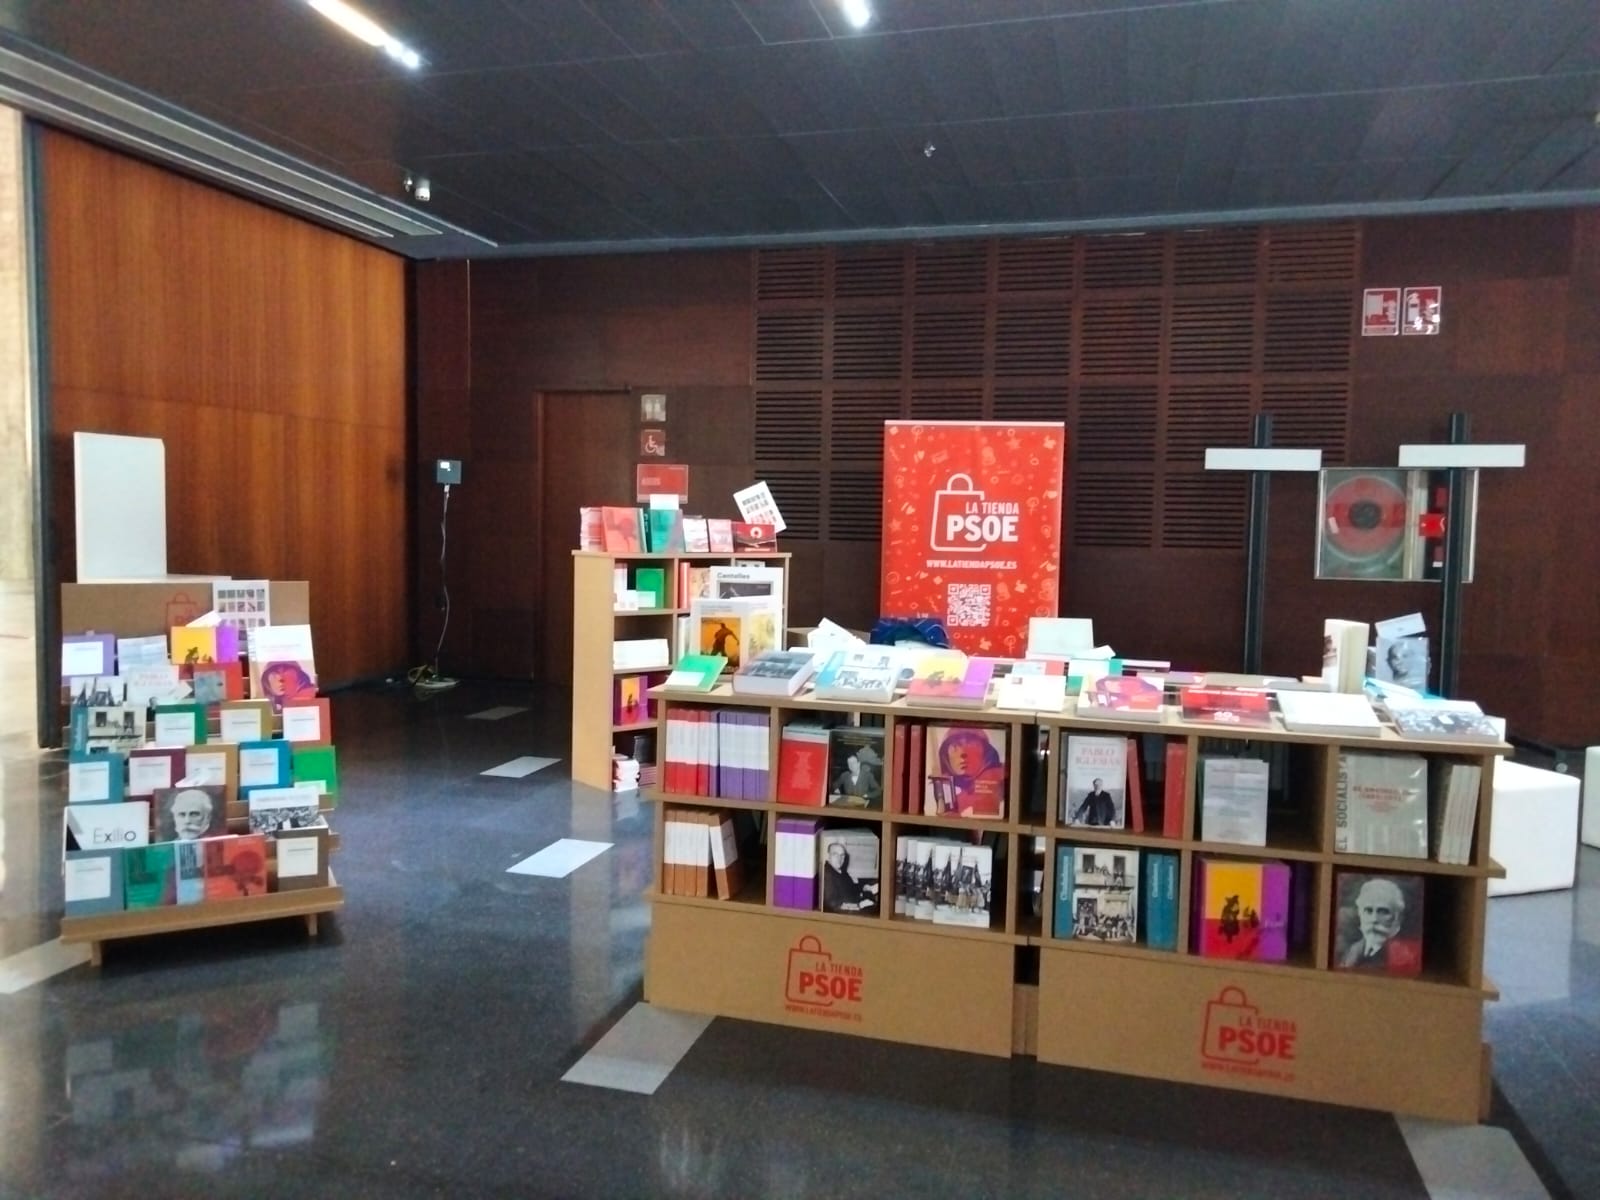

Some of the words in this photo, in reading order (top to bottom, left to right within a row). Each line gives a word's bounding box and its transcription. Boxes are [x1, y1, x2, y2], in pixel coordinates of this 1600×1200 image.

[965, 501, 979, 514] LA
[981, 502, 1020, 515] TIENDA
[946, 514, 1019, 542] PSOE
[93, 827, 137, 844] Exilio
[815, 961, 826, 973] LA
[830, 963, 864, 978] TIENDA
[799, 971, 863, 1003] PSOE
[1218, 1026, 1297, 1060] PSOE
